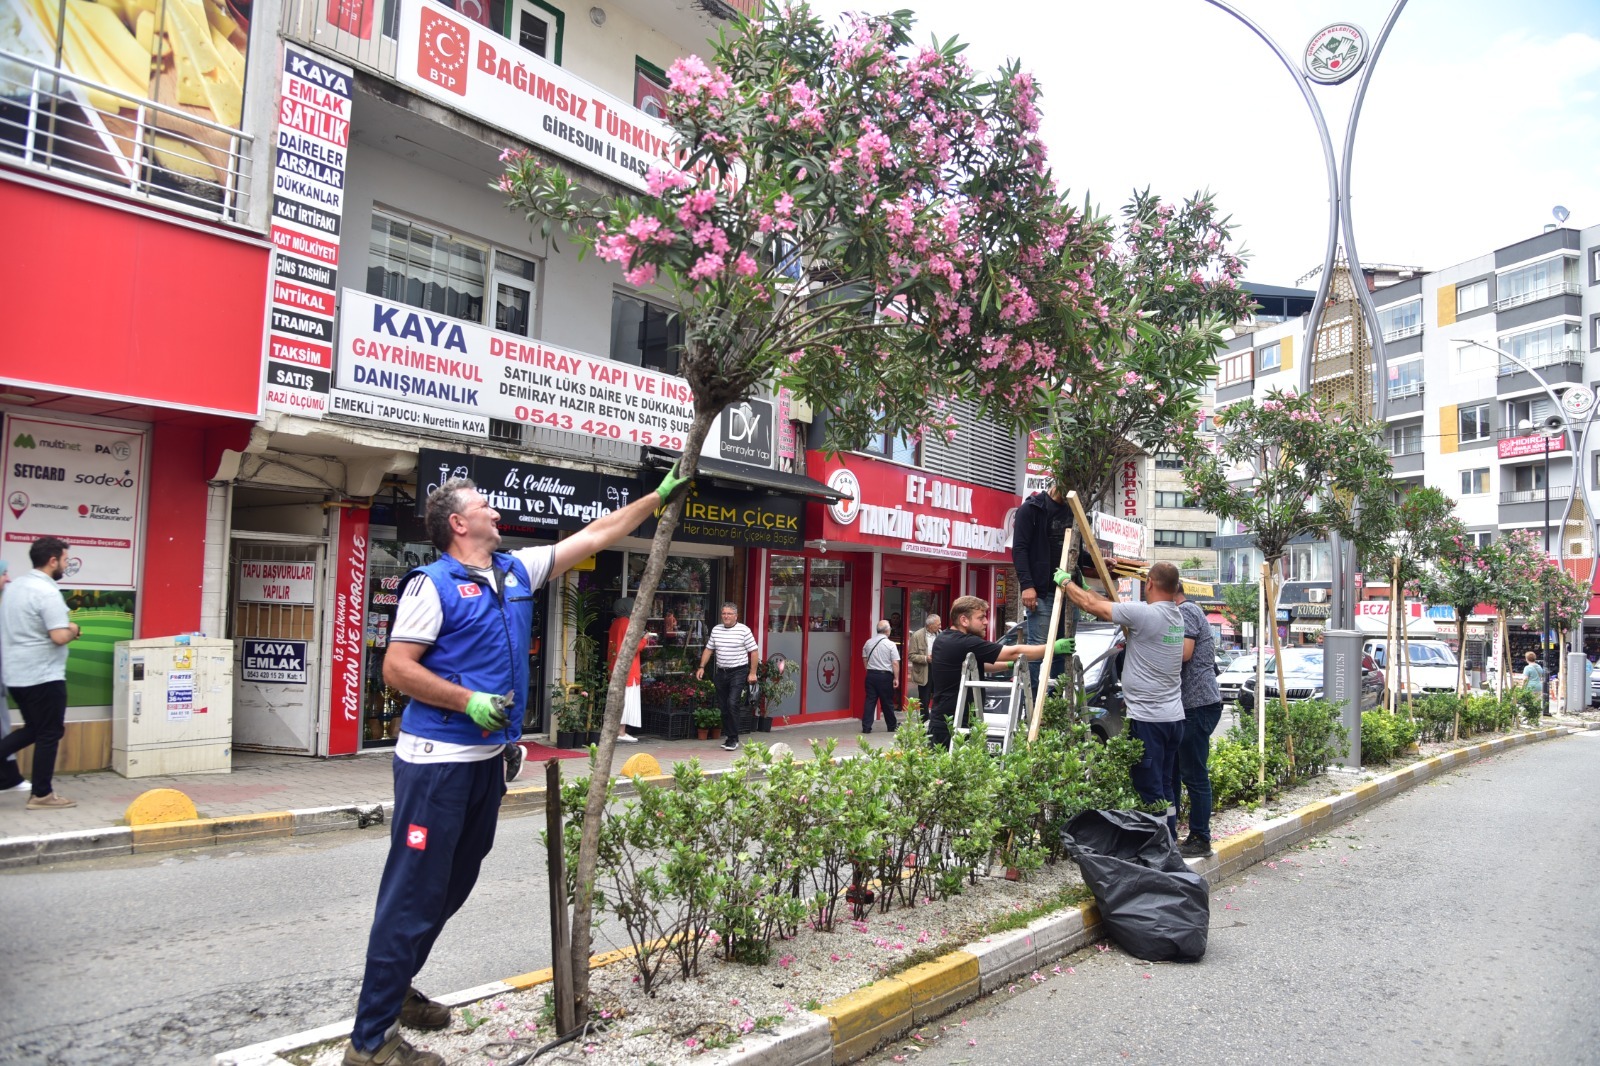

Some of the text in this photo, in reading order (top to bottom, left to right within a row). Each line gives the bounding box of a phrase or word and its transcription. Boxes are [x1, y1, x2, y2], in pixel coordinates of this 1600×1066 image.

[1327, 27, 1360, 39] BELEDİYESİ
[292, 55, 349, 96] KAYA
[430, 67, 457, 88] BTP
[289, 79, 343, 115] EMLAK
[477, 40, 588, 122] BAĞIMSIZ
[592, 99, 670, 163] TÜRKİYE
[281, 98, 347, 146] SATILIK
[279, 131, 343, 168] DAİRELER
[543, 115, 617, 163] GİRESUN İL
[278, 152, 341, 188] ARSALAR
[277, 201, 336, 232] KAT İRTİFAKI
[273, 232, 336, 261] KAT MÜLKİYETİ
[297, 264, 331, 285] TASHİHİ
[275, 283, 326, 310] İNTİKAL
[273, 312, 324, 336] TRAMPA
[373, 303, 468, 355] KAYA
[273, 343, 321, 365] TAKSİM
[352, 338, 484, 383] GAYRİMENKUL
[490, 337, 581, 376] DEMİRAY
[588, 362, 628, 388] YAPI
[634, 374, 656, 394] VE
[276, 370, 314, 391] SATIŞ
[353, 365, 479, 406] DANIŞMANLIK
[504, 365, 694, 420] SATILIK LÜKS DAİRE VE DÜKKANLA
[290, 393, 325, 411] ÖLÇÜMÜ
[334, 396, 486, 434] EMEKLİ TAPUCU: Nurettin KAYA
[500, 382, 556, 405] DEMİRAY
[559, 395, 596, 413] HAZIR
[598, 404, 636, 422] BETON
[638, 413, 668, 432] SATIŞ
[514, 405, 683, 450] 0543 420 15 29
[729, 407, 760, 443] DY
[39, 438, 82, 452] multinet
[14, 463, 66, 482] SETCARD
[74, 472, 134, 488] sodexo
[504, 468, 576, 495] Öz Çelikhan
[91, 504, 120, 515] Ticket
[476, 488, 610, 524] ütün ve Nargile
[906, 474, 973, 514] ET-BALIK
[685, 497, 798, 530] İREM ÇİÇEK
[859, 503, 914, 540] TANZİM
[915, 513, 950, 549] SATIŞ
[683, 523, 700, 534] Her
[703, 524, 728, 537] bahar
[731, 528, 742, 539] Bir
[243, 563, 314, 582] TAPU BAŞVURULARI
[263, 584, 290, 600] YAPILIR
[341, 534, 366, 721] TÜTÜN VE NARGİLE
[247, 657, 302, 670] EMLAK
[254, 643, 295, 656] KAYA
[333, 644, 345, 662] ÖZ
[247, 670, 259, 679] 0543
[260, 671, 270, 679] 420
[271, 671, 277, 679] 15
[277, 671, 285, 680] 29
